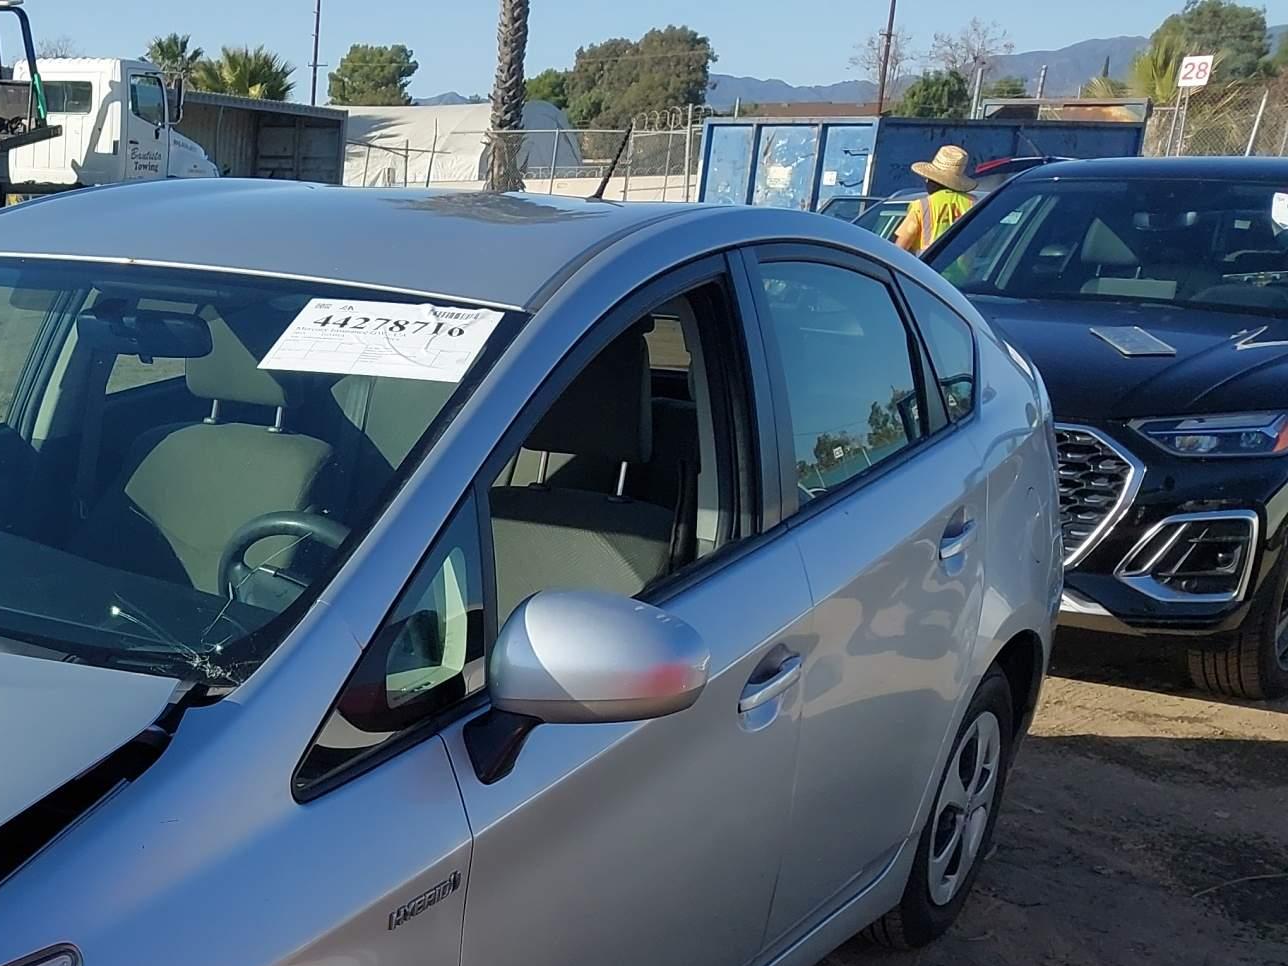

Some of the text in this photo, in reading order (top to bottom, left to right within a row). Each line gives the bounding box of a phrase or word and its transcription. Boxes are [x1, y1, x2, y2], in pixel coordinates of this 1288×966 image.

[1181, 62, 1209, 80] 28
[134, 161, 159, 172] Towing
[388, 870, 462, 930] HYBRID
